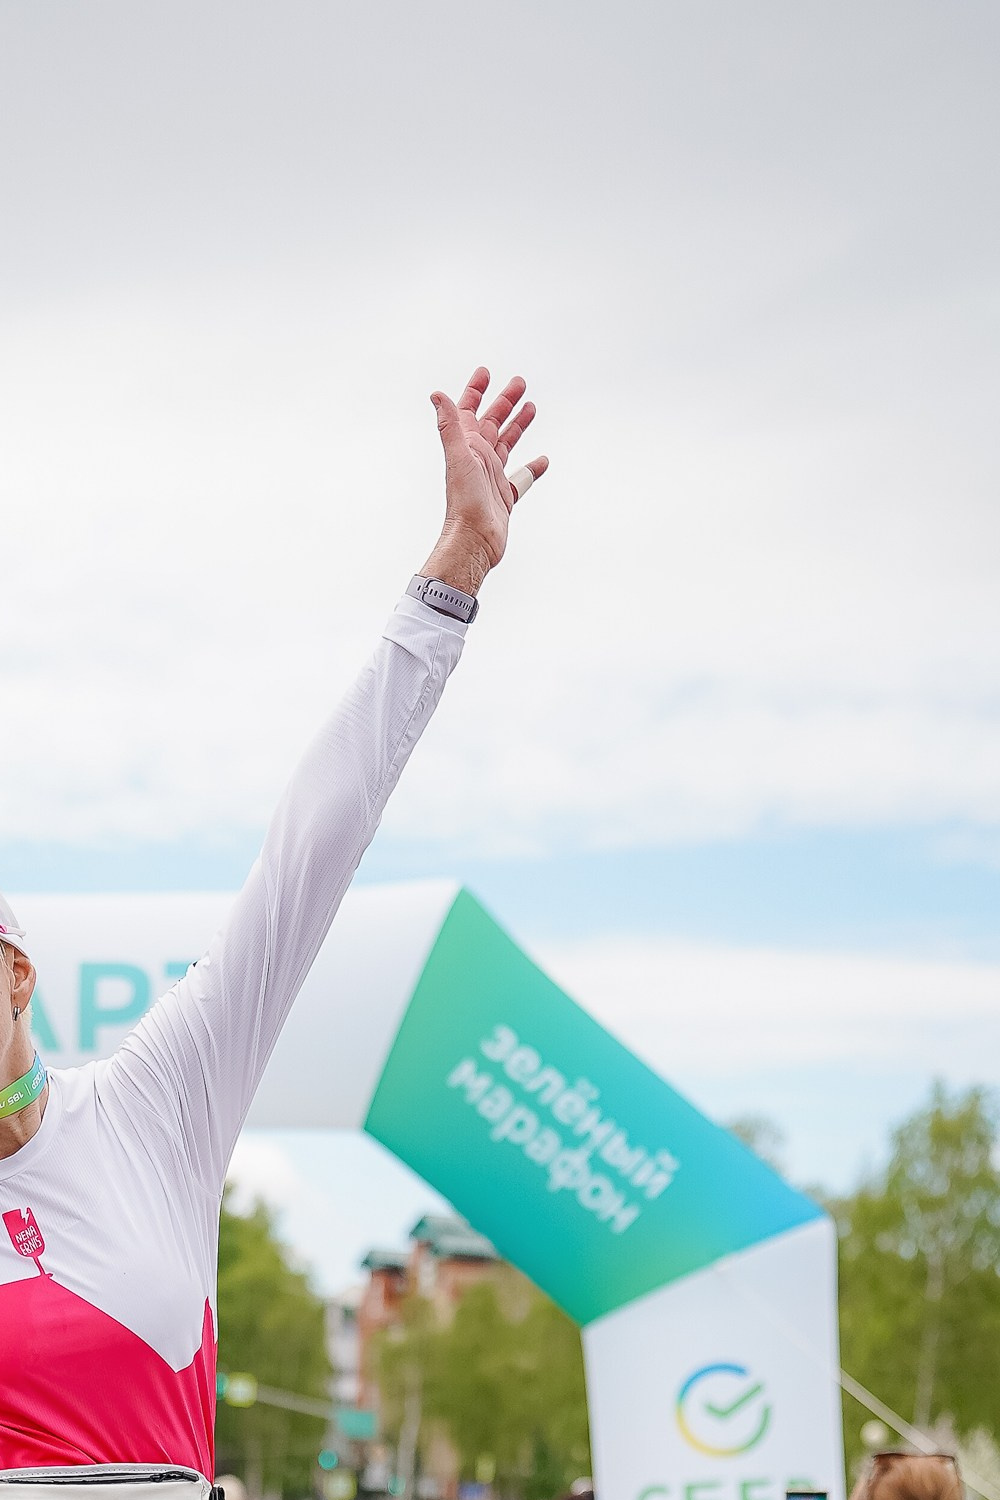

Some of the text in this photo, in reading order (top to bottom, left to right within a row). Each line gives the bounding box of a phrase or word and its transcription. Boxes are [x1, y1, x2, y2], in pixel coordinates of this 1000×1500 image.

[8, 1091, 24, 1106] 185
[447, 1058, 640, 1234] марафон
[479, 1024, 679, 1199] зелёный
